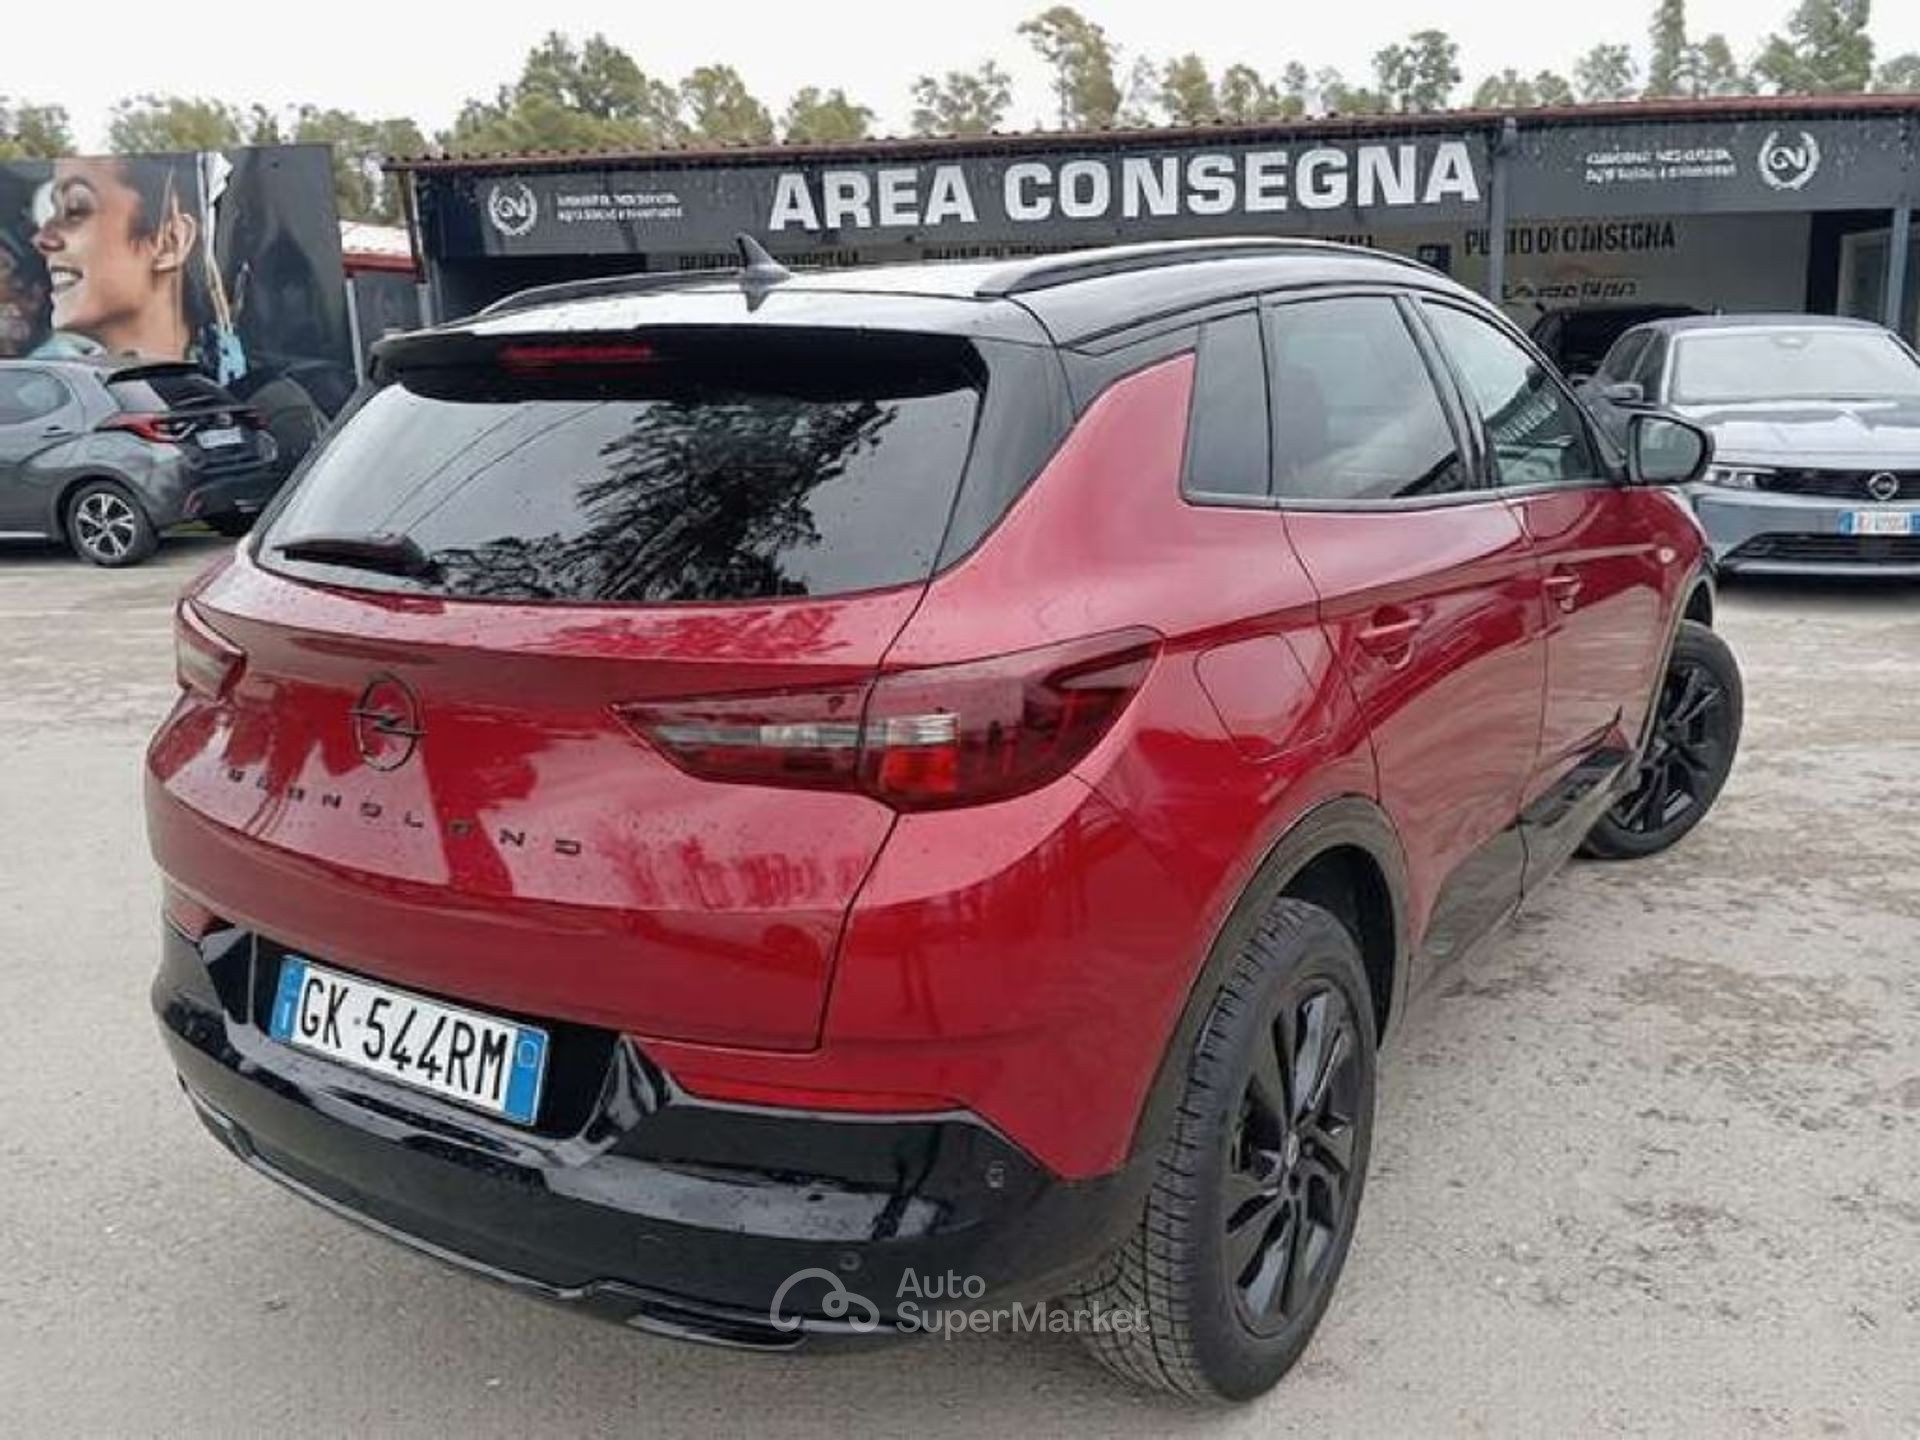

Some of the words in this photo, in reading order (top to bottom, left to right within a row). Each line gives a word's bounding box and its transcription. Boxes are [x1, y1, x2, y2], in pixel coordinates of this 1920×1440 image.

[769, 165, 978, 231] AREA
[1004, 141, 1481, 221] CONSEGNA
[301, 978, 349, 1050] GK
[362, 997, 508, 1101] 544RM
